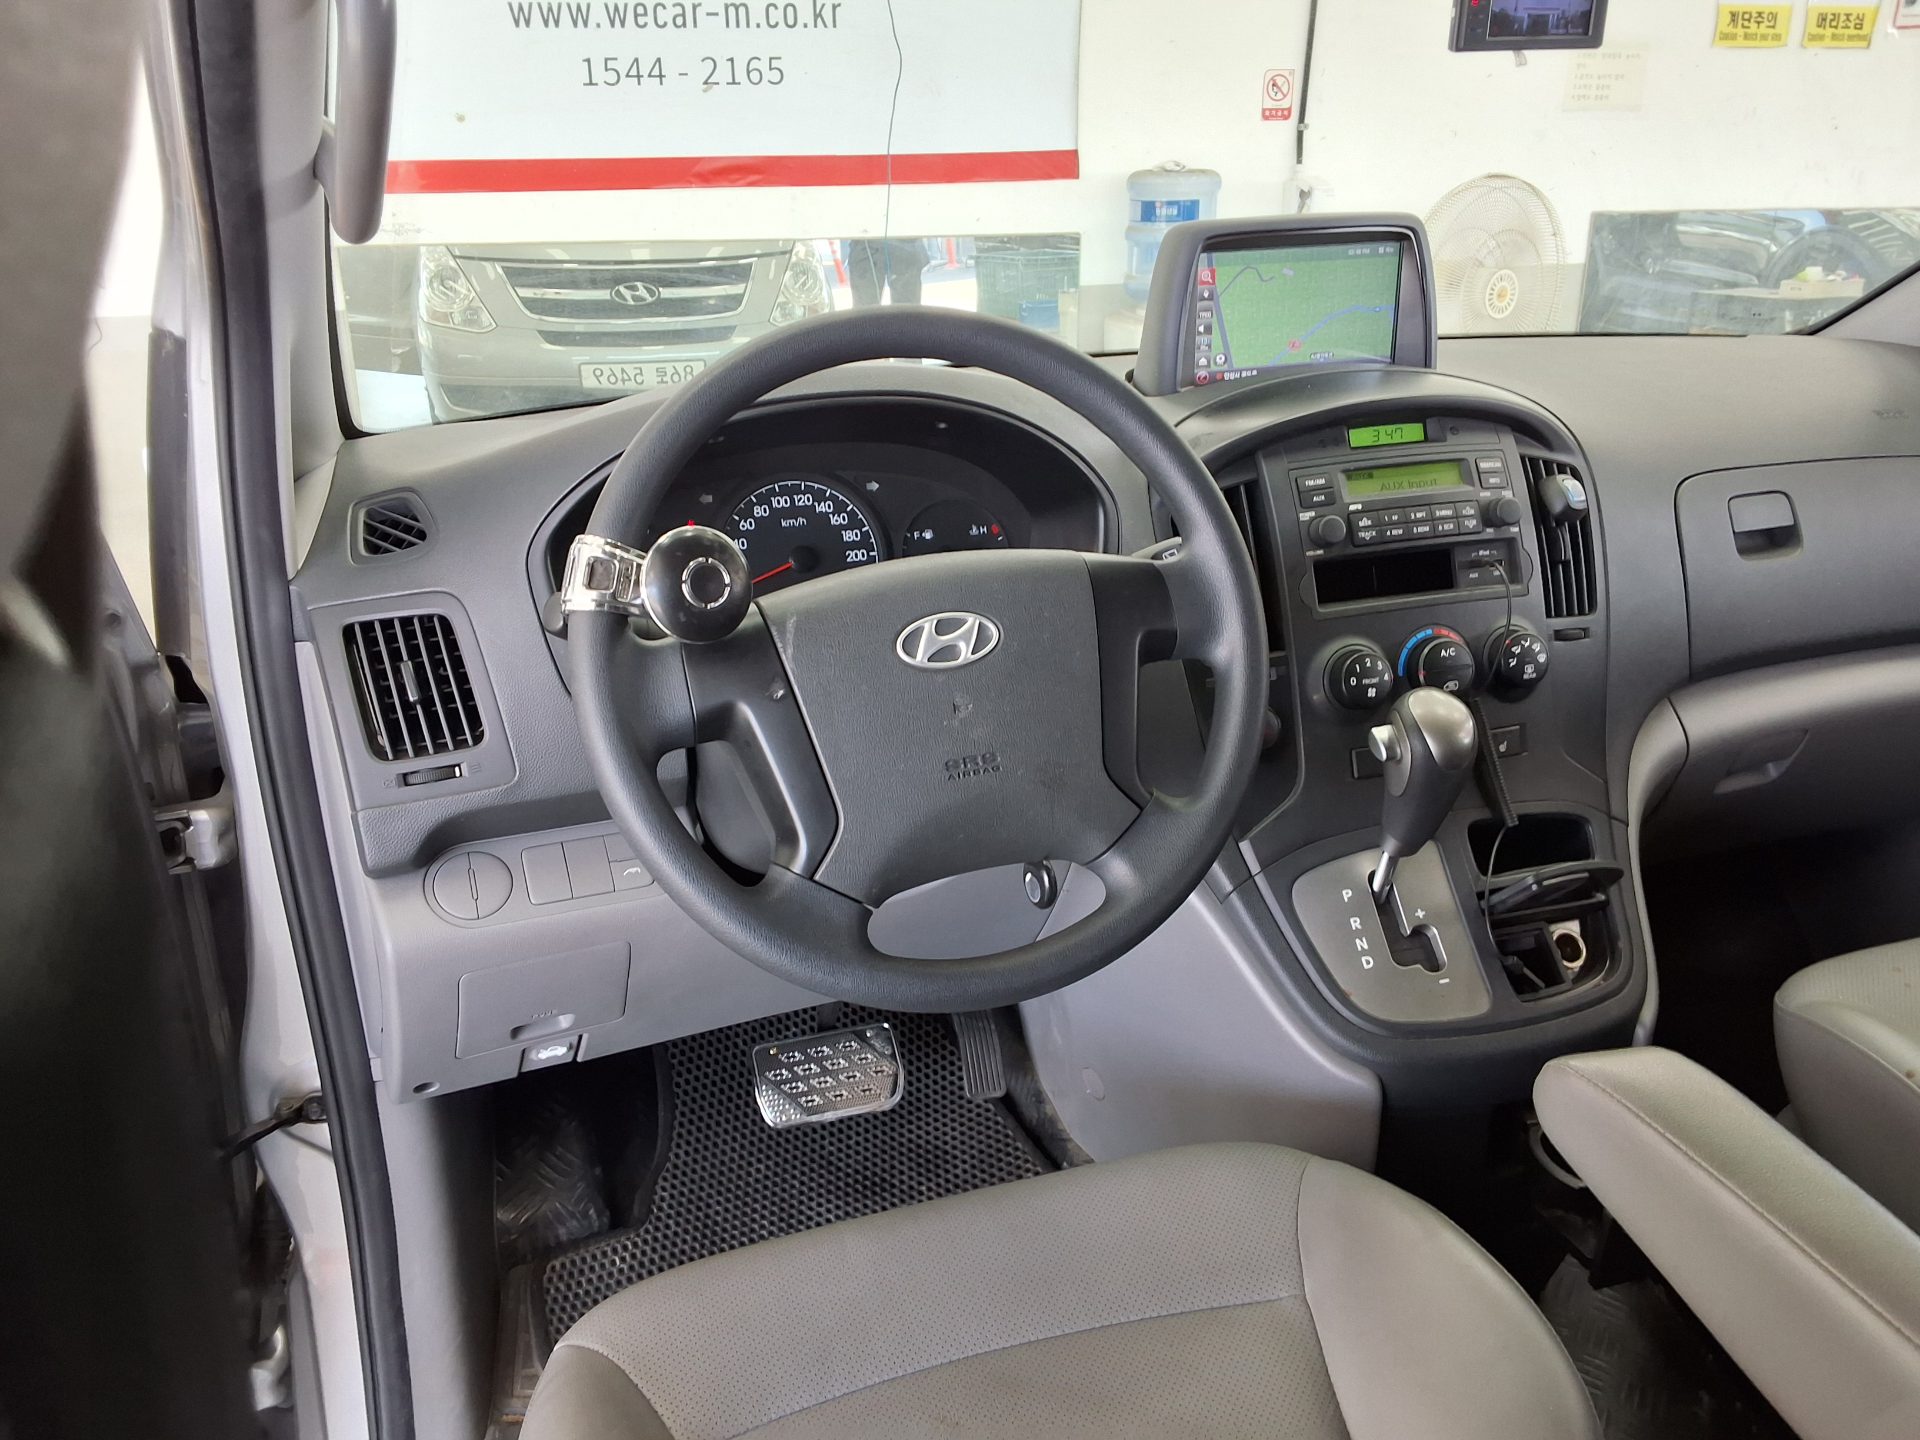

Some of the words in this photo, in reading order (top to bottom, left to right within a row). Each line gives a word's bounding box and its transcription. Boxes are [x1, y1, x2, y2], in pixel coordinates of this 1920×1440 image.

[507, 0, 842, 29] www.wecar-m.co.kr
[1727, 10, 1778, 29] 계단주의
[1816, 12, 1865, 30] 머리조심
[582, 57, 667, 87] 1544
[700, 56, 785, 87] 2165
[770, 495, 790, 508] 100
[793, 494, 813, 506] 120
[753, 505, 770, 518] 80
[814, 501, 834, 514] 140
[739, 518, 755, 531] 60
[780, 517, 807, 528] km/h
[829, 513, 848, 526] 160
[841, 529, 861, 542] 180
[913, 530, 920, 540] F
[979, 525, 988, 535] H
[845, 549, 868, 562] 200
[1440, 647, 1456, 658] A/C
[1341, 889, 1352, 903] P
[1349, 917, 1362, 930] R
[1355, 936, 1369, 951] N
[1361, 956, 1374, 969] D
